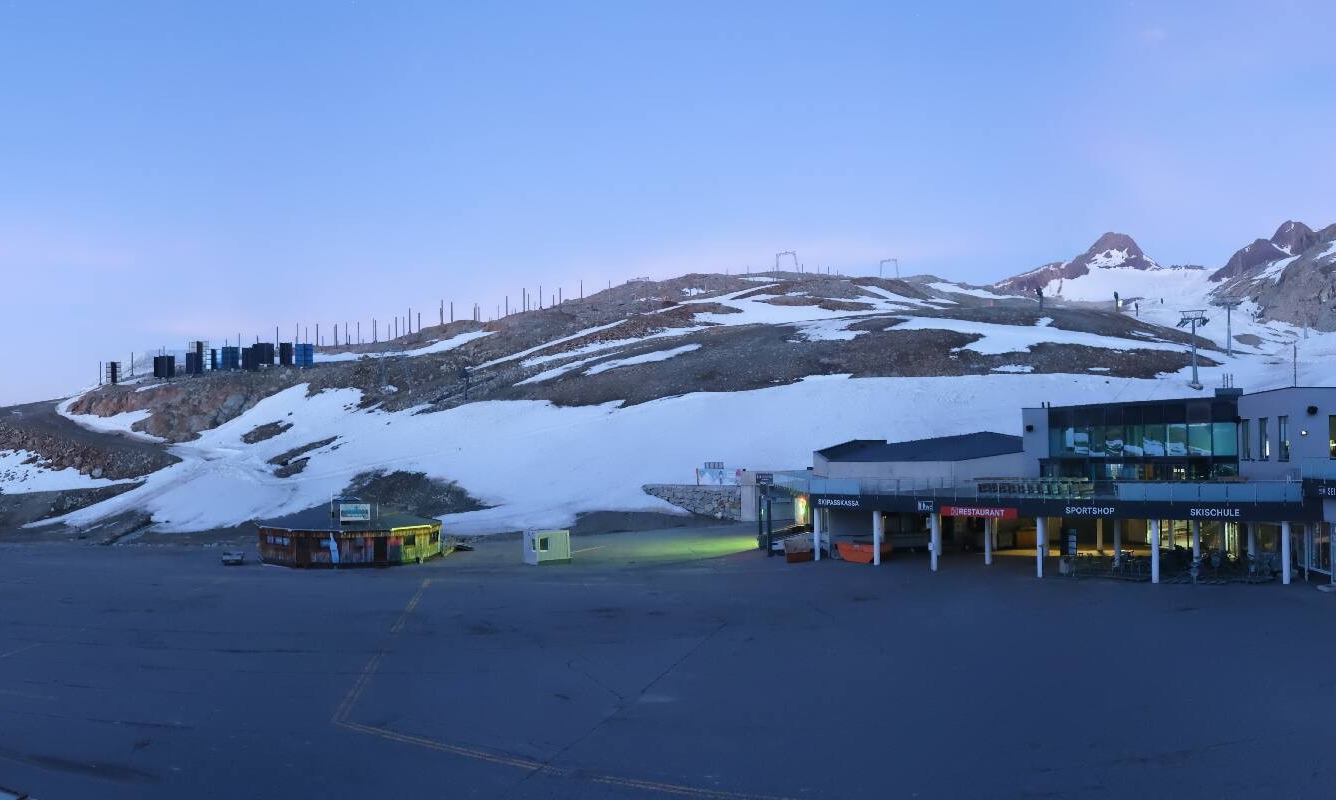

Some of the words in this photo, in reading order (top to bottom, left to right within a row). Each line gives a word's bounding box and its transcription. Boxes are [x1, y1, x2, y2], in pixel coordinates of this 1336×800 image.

[817, 498, 860, 507] SKIPASSKASSA
[958, 508, 1005, 517] RESTAURANT
[1065, 506, 1115, 515] SPORTSHOP
[1190, 508, 1240, 517] SKISCHULE
